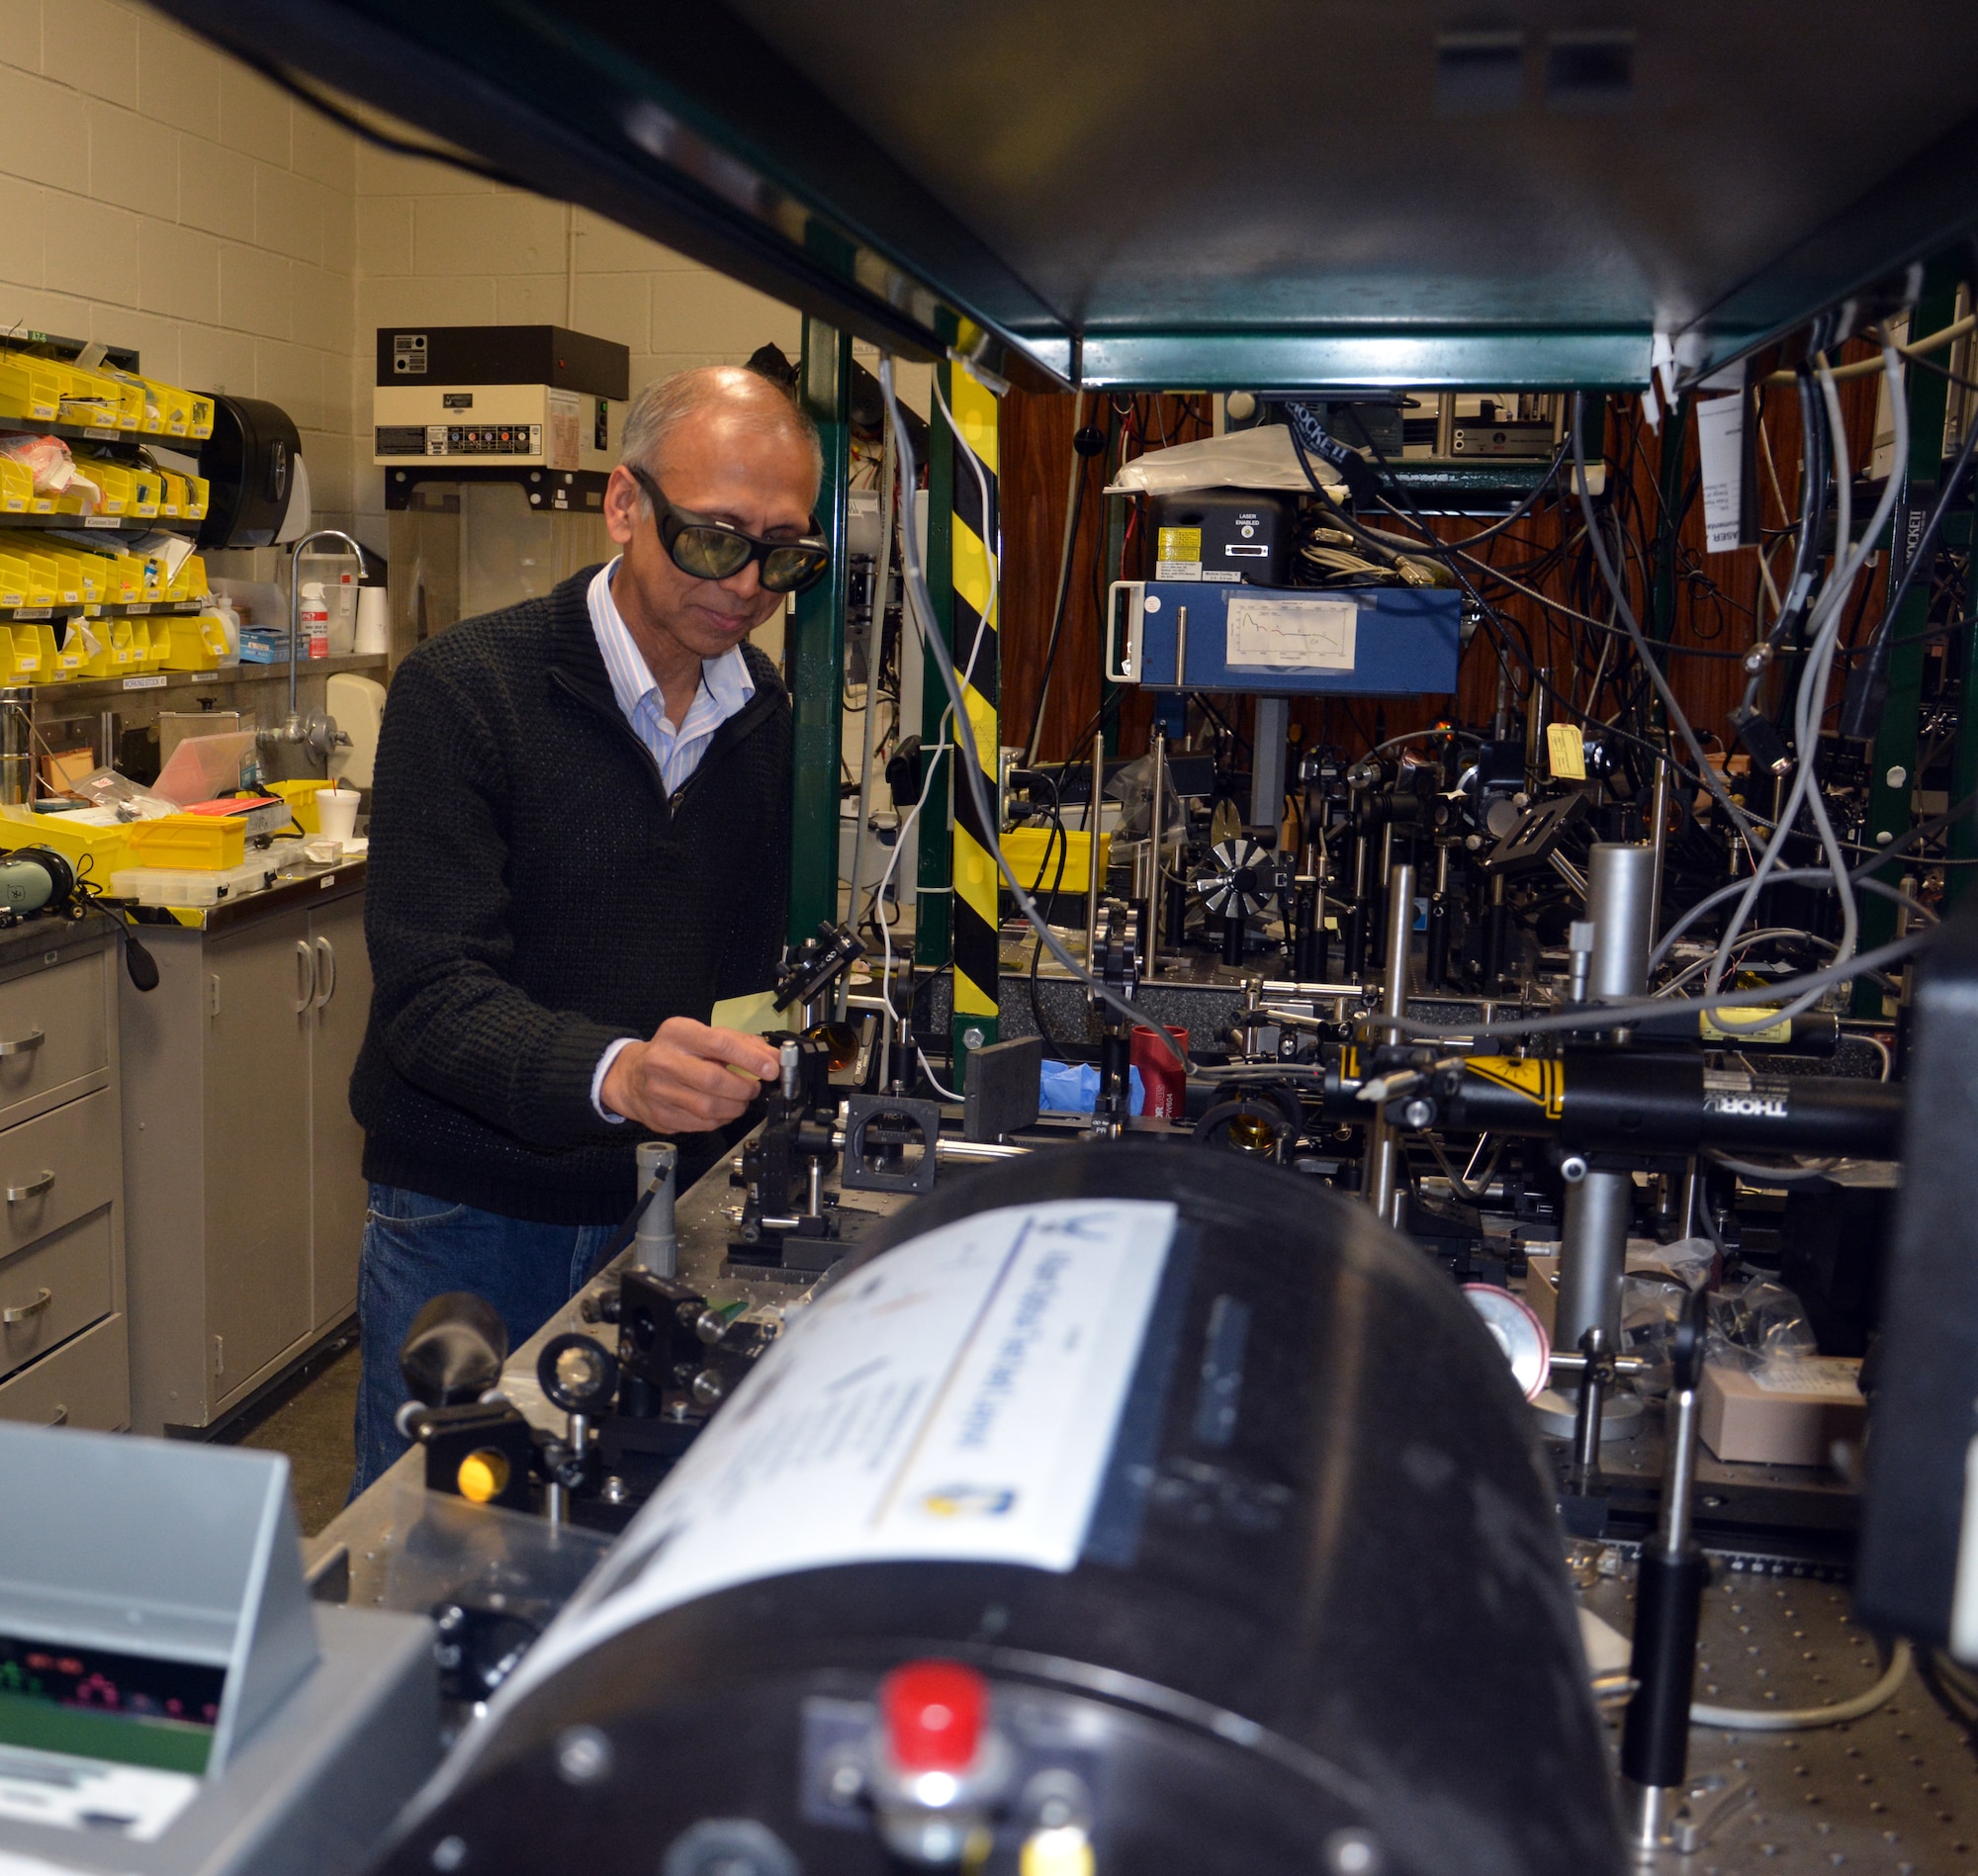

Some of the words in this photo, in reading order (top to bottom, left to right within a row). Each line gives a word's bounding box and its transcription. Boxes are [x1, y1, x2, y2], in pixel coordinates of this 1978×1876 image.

[32, 332, 46, 343] A7-6
[1713, 531, 1740, 543] ASER
[125, 678, 144, 688] WORKING
[144, 677, 159, 686] STOCK
[1702, 1097, 1788, 1118] THORL
